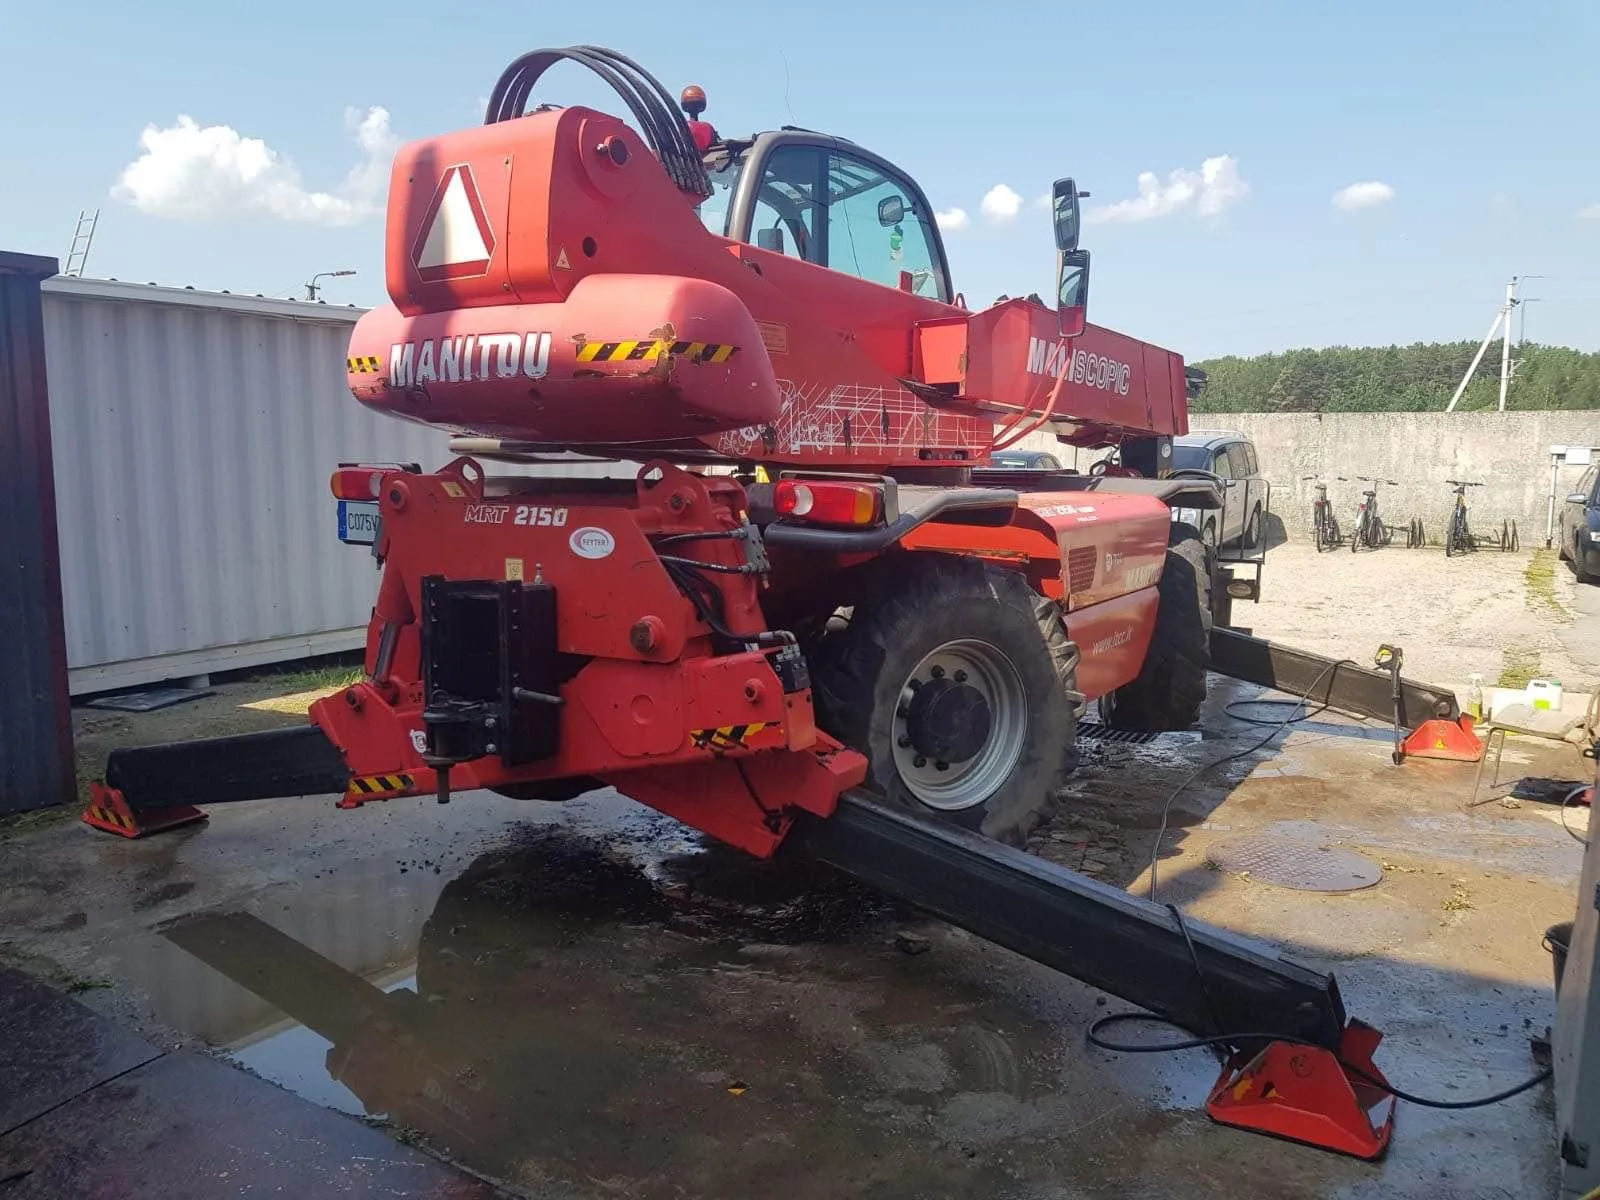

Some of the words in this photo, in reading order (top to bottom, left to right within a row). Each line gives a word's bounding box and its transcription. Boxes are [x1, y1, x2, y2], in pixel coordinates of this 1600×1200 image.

[389, 332, 552, 387] MANITOU
[1026, 336, 1131, 396] MANISCOPIC
[464, 504, 509, 524] MRT
[514, 505, 568, 527] 2150
